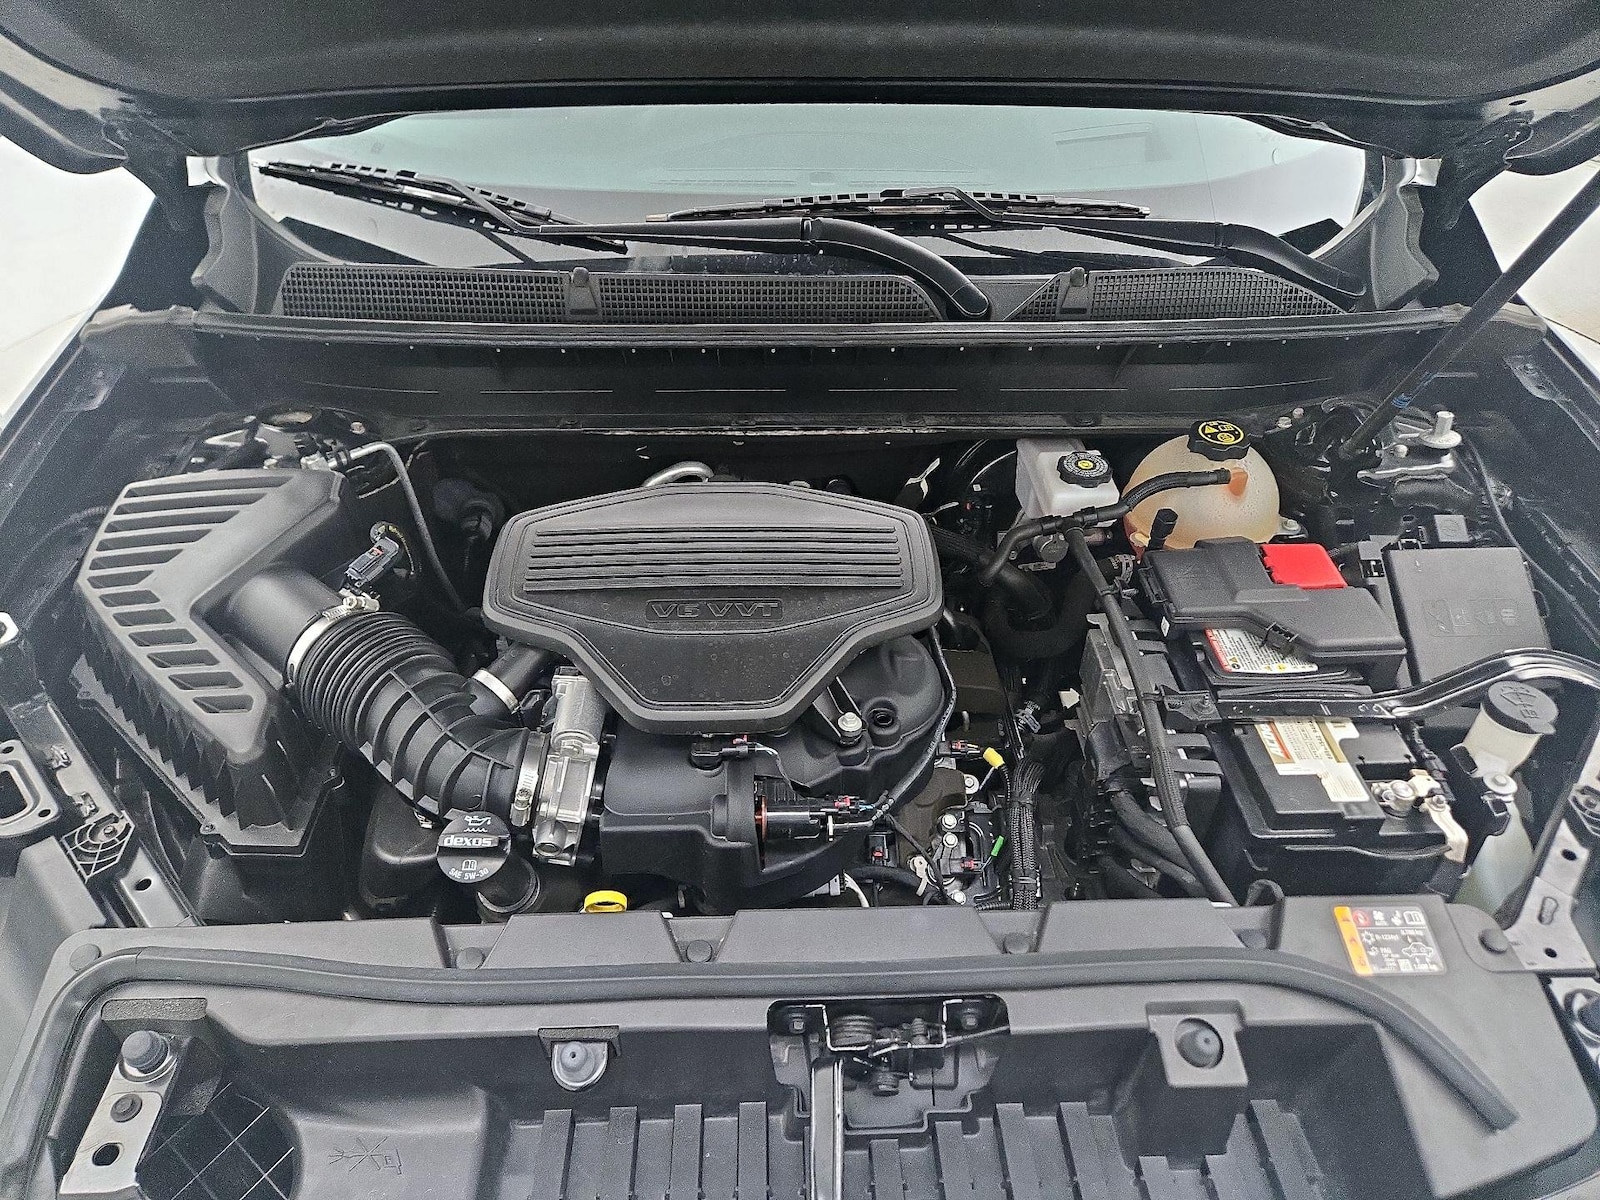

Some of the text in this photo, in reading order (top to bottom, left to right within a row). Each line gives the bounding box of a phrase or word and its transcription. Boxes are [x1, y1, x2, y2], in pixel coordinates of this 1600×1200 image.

[651, 601, 779, 618] V6 VVT
[443, 834, 492, 847] dexos
[448, 867, 489, 880] SAE 5W-30
